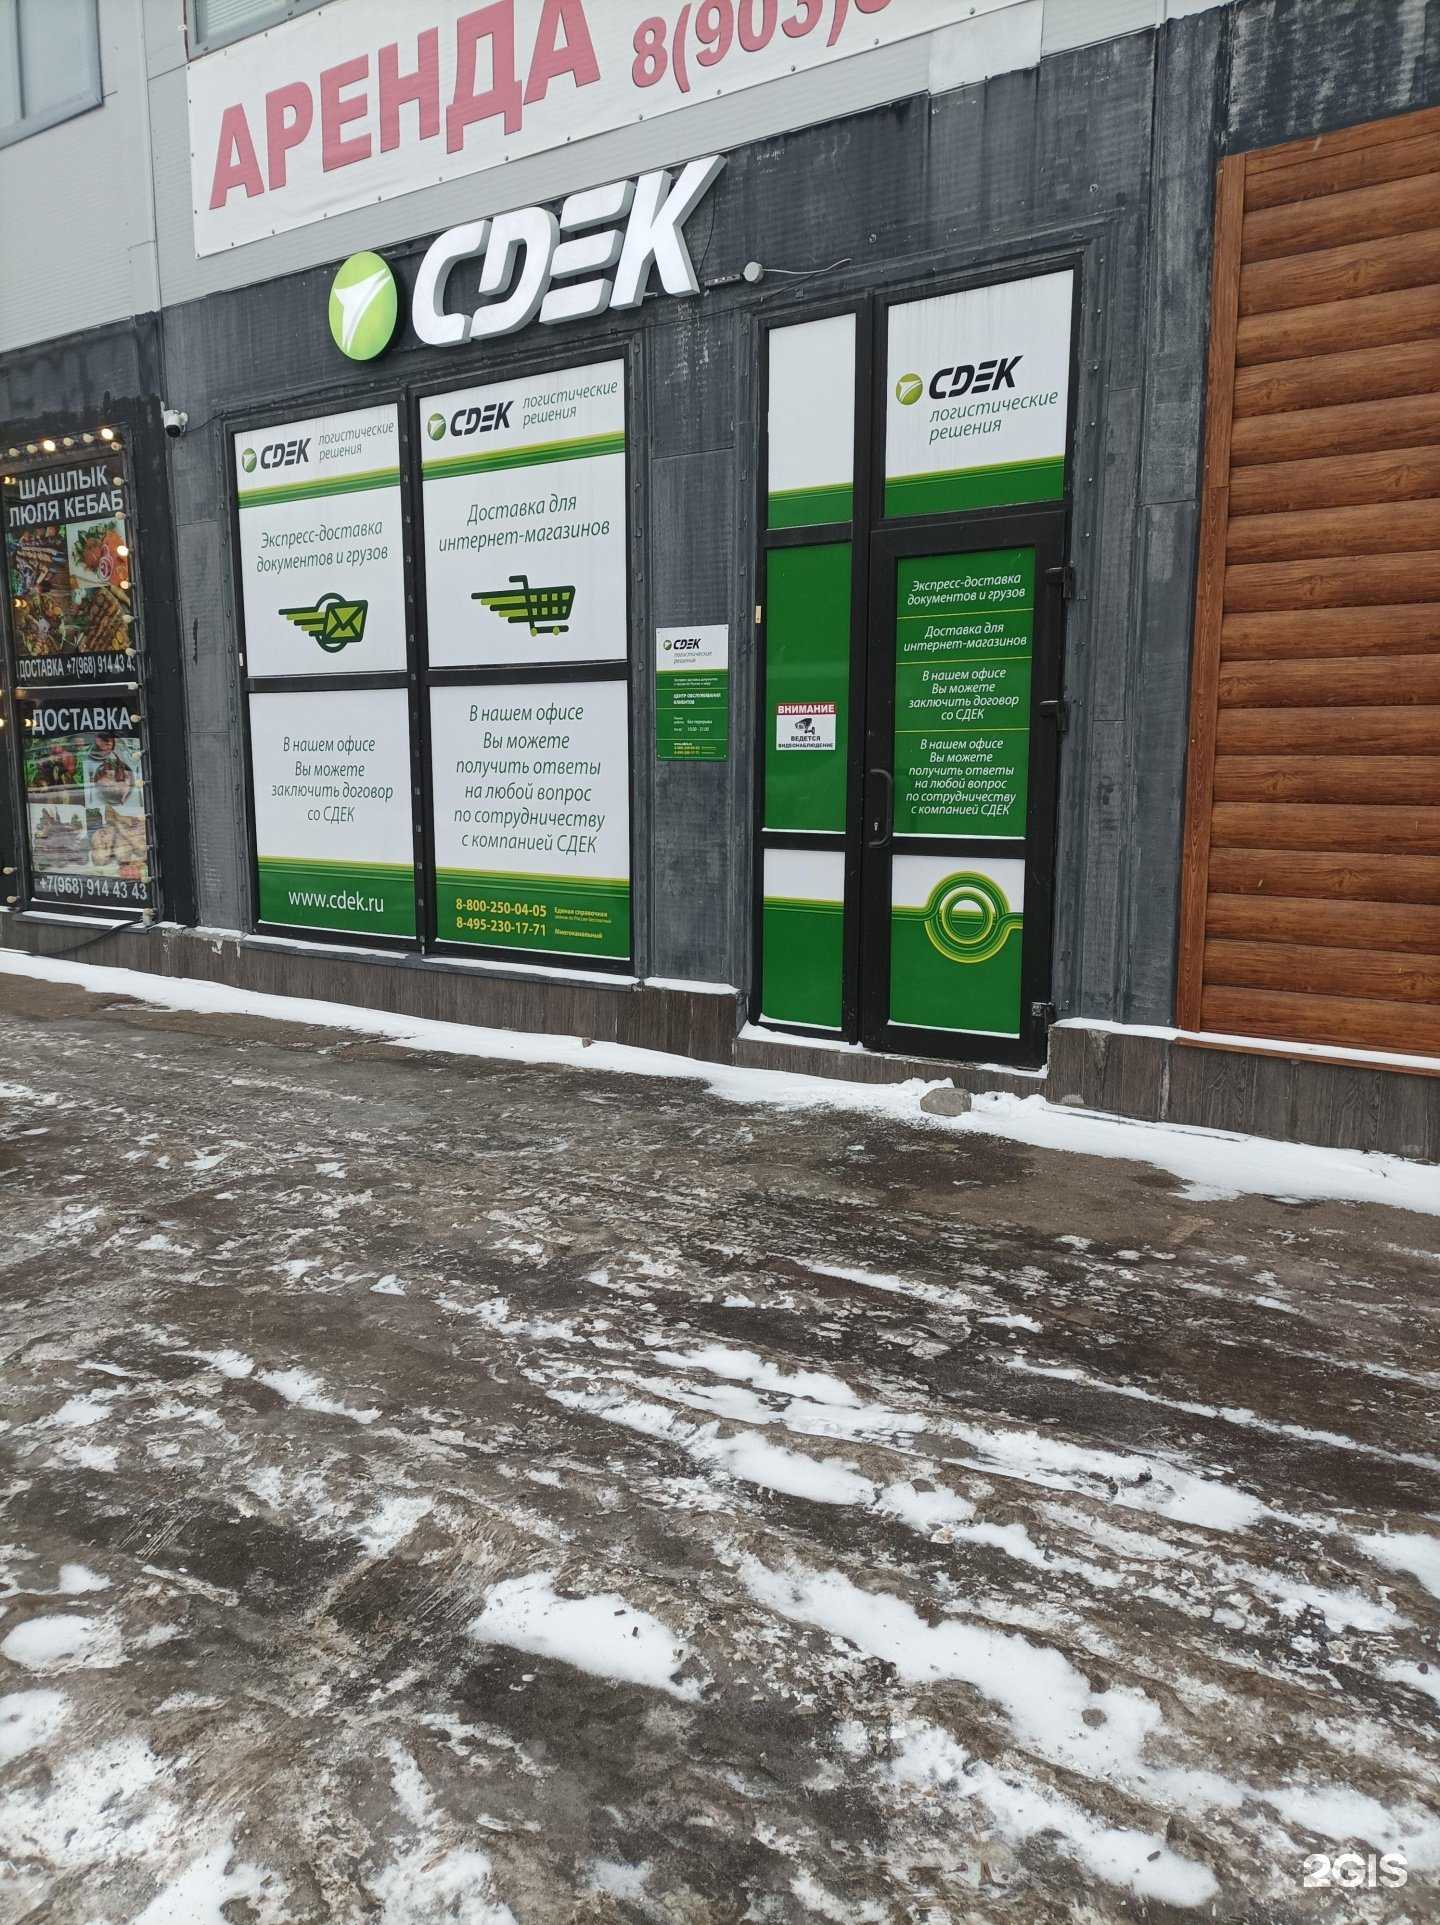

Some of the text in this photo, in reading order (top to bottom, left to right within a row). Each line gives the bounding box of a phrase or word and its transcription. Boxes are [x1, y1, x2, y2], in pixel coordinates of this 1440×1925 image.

[209, 0, 893, 210] АРЕНДА 8(903)
[412, 154, 726, 347] CDEK
[929, 355, 1023, 399] CDEK
[522, 381, 618, 409] логистические
[929, 391, 1058, 422] логистические
[450, 400, 514, 436] CDEK
[523, 406, 576, 429] решения
[318, 422, 394, 446] логистические
[929, 419, 1001, 445] решения
[261, 438, 311, 469] CDEK
[319, 444, 362, 464] решения
[19, 465, 108, 500] ШАШЛЫК
[9, 489, 124, 527] ЛЮЛЯ КЕБАБ
[467, 494, 577, 526] Доставка для
[261, 520, 383, 549] Экспресс-доставка
[439, 520, 610, 552] интернет-магазинов
[256, 545, 388, 575] документов и грузов
[912, 574, 1021, 592] Экспресс-доставка
[907, 588, 1025, 607] документов и грузов
[924, 622, 1004, 639] Доставка для
[673, 639, 701, 650] CDEK
[904, 637, 1027, 652] интернет-магазинов
[20, 659, 64, 680] ДОСТАВКА
[67, 656, 96, 678] +7(968)
[97, 655, 113, 673] 914
[114, 654, 125, 672] 43
[922, 668, 1006, 681] В нашем офисе
[932, 683, 995, 694] Вы можете
[778, 704, 834, 714] ВНИМАНИЕ
[909, 695, 1019, 708] заключить договор
[31, 707, 133, 735] ДОСТАВКА
[469, 702, 584, 724] В нашем офисе
[941, 709, 985, 722] со СДЕК
[283, 736, 376, 755] В нашем офисе
[483, 732, 570, 749] Вы можете
[920, 738, 1003, 751] В нашем офисе
[930, 752, 993, 762] Вы можете
[295, 761, 365, 776] Вы можете
[456, 761, 601, 777] получить ответы
[909, 767, 1014, 777] получить ответы
[271, 782, 394, 802] заключить договор
[465, 782, 592, 805] на любой вопрос
[915, 778, 1007, 791] на любой вопрос
[906, 791, 1016, 806] по сотрудничеству
[307, 806, 355, 824] со СДЕК
[454, 807, 605, 832] по сотрудничеству
[911, 804, 1010, 817] с компанией СДЕК
[461, 834, 598, 856] с компанией СДЕК
[40, 875, 147, 900] +7(968) 914 43 43
[288, 890, 384, 912] www.cdek.ru
[456, 898, 547, 918] 8-800-250-04-05
[456, 916, 547, 936] 8-495-230-17-71
